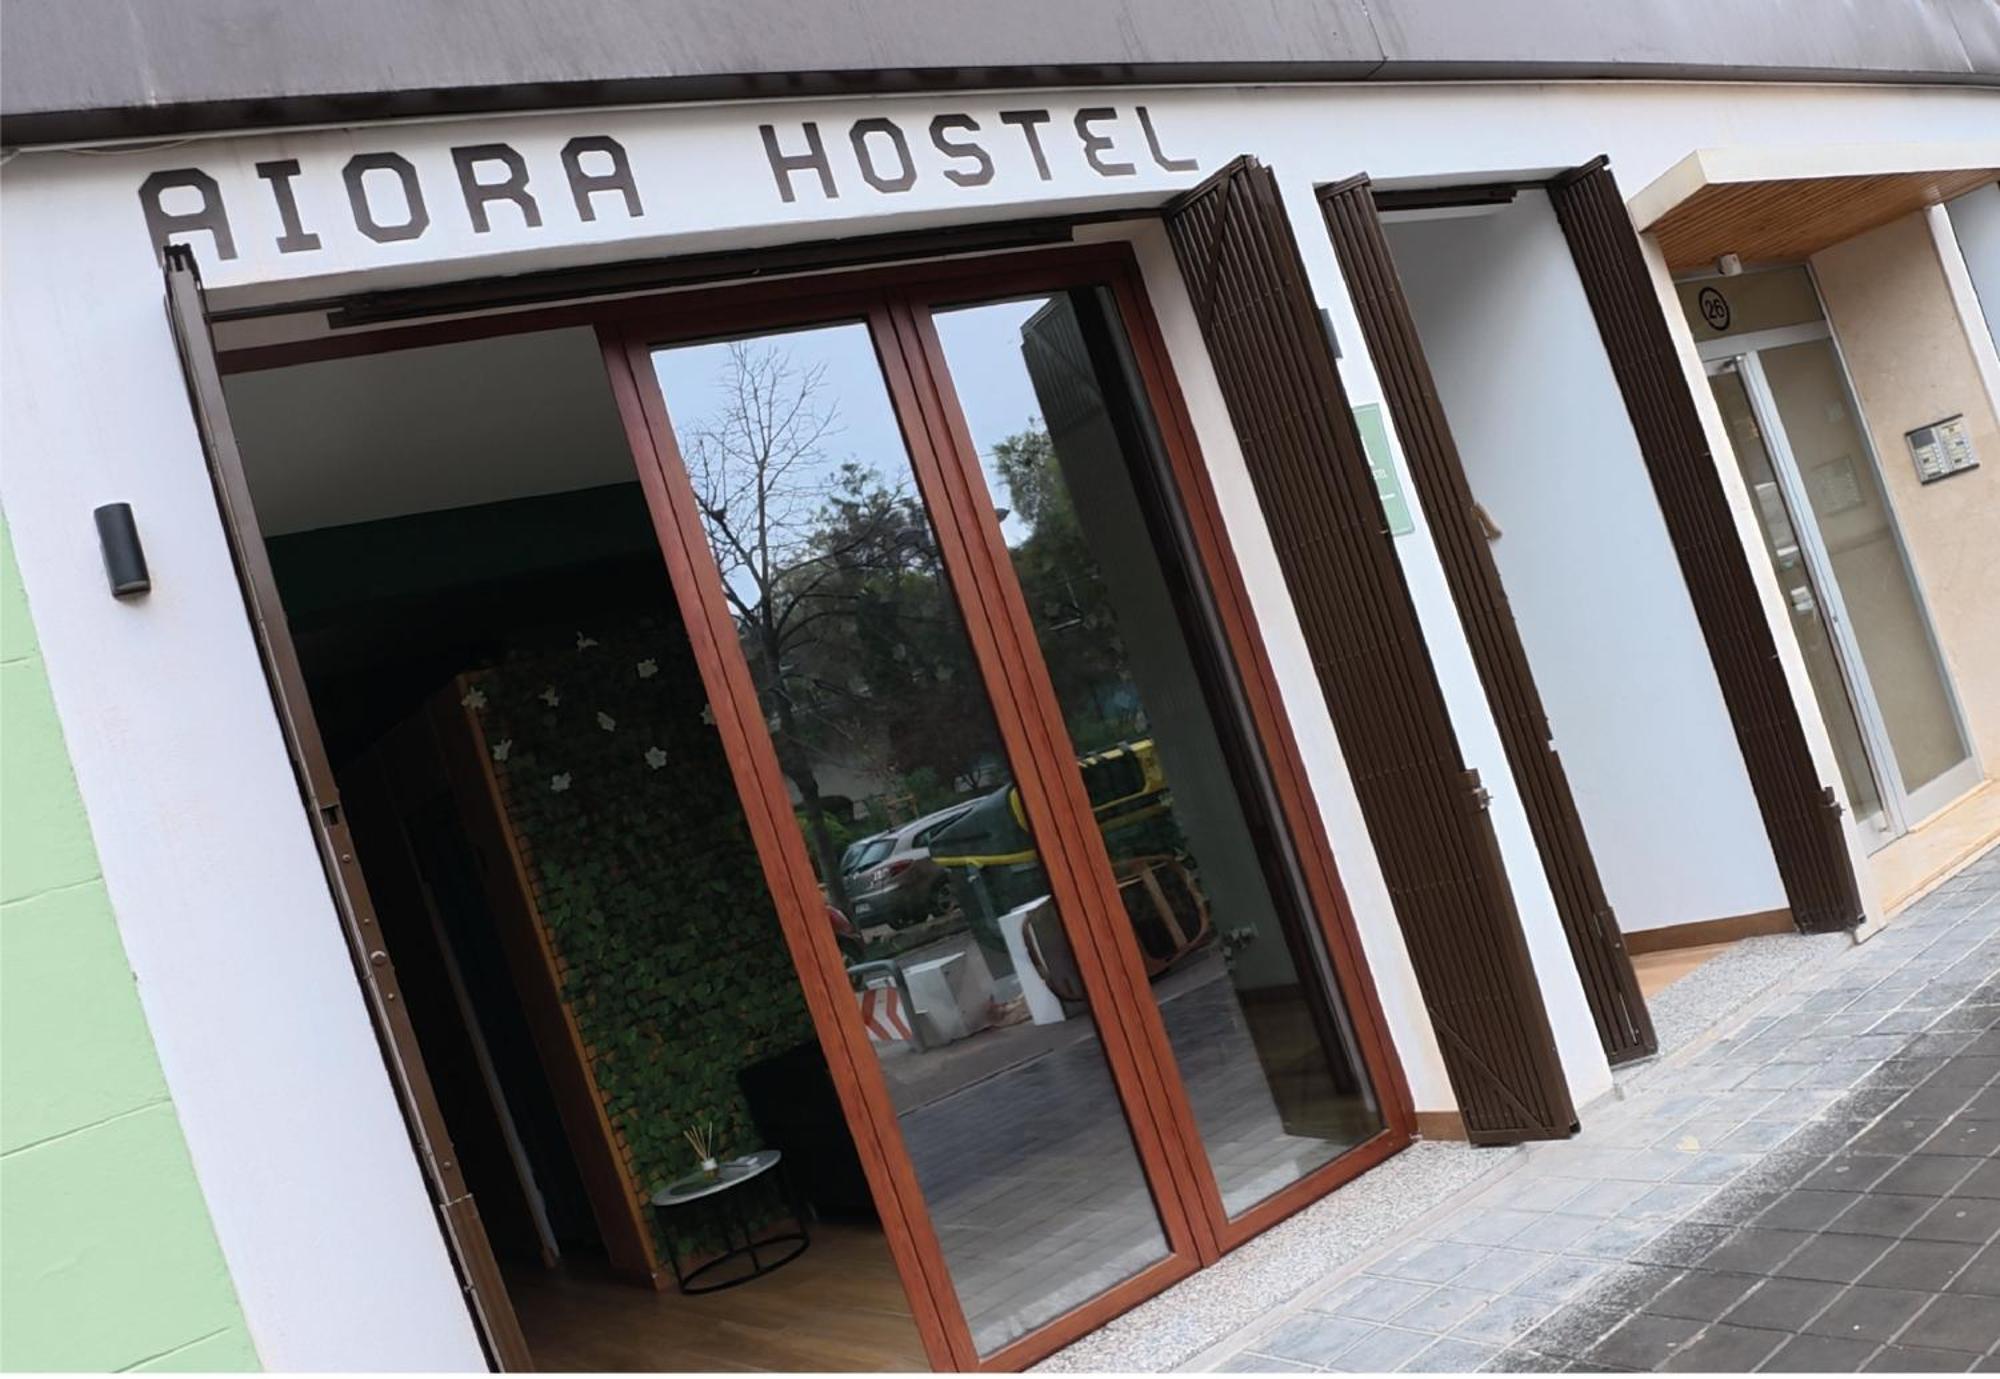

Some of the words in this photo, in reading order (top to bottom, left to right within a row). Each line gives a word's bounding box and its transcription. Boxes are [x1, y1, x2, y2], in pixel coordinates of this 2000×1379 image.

[138, 135, 644, 268] AIORA
[758, 105, 1199, 202] HOSTEL
[1704, 298, 1726, 319] 26
